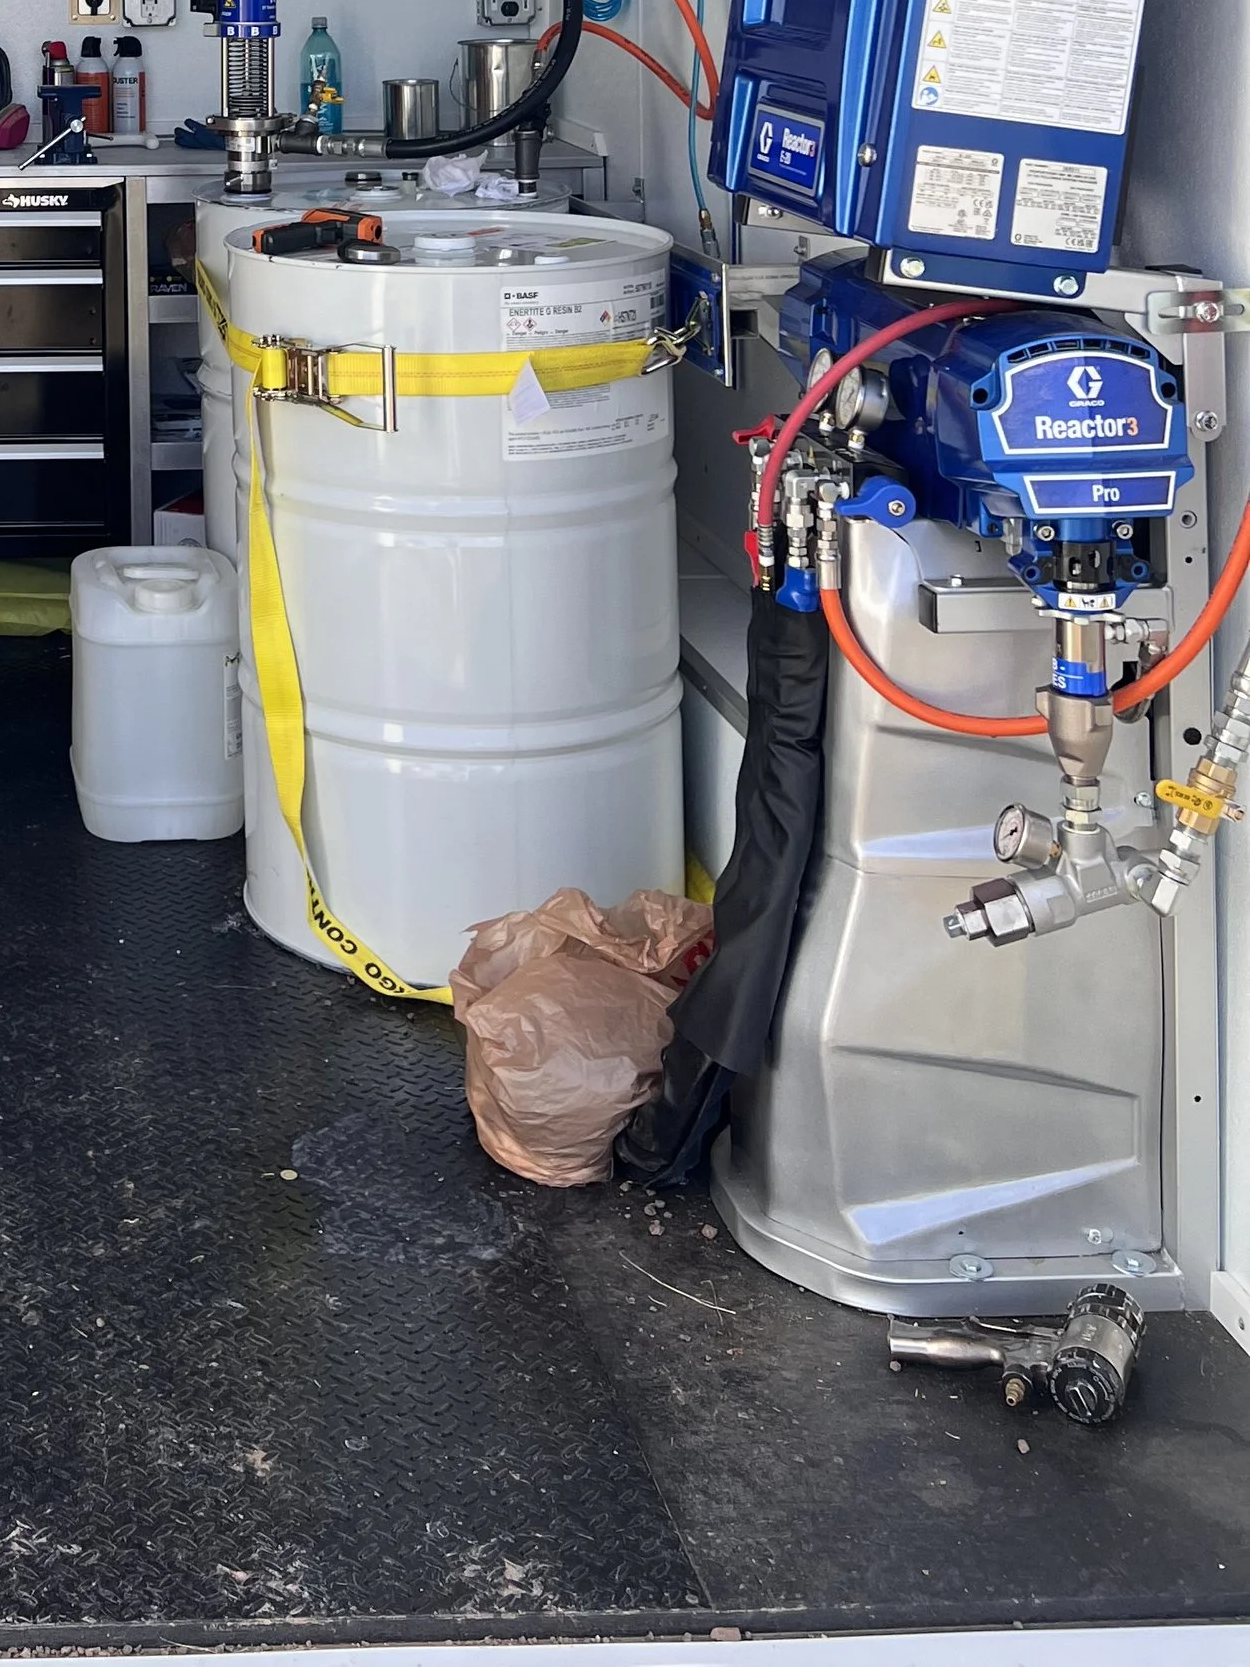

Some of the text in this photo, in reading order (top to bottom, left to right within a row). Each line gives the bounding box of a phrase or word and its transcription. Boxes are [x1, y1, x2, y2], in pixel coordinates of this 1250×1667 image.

[227, 26, 235, 36] B
[251, 26, 260, 36] B
[20, 195, 69, 207] HUSKY
[150, 283, 188, 293] RAVEN
[516, 291, 539, 300] BASF
[553, 305, 574, 315] RESIN
[1068, 399, 1105, 408] GRACO
[1092, 484, 1120, 502] Pro
